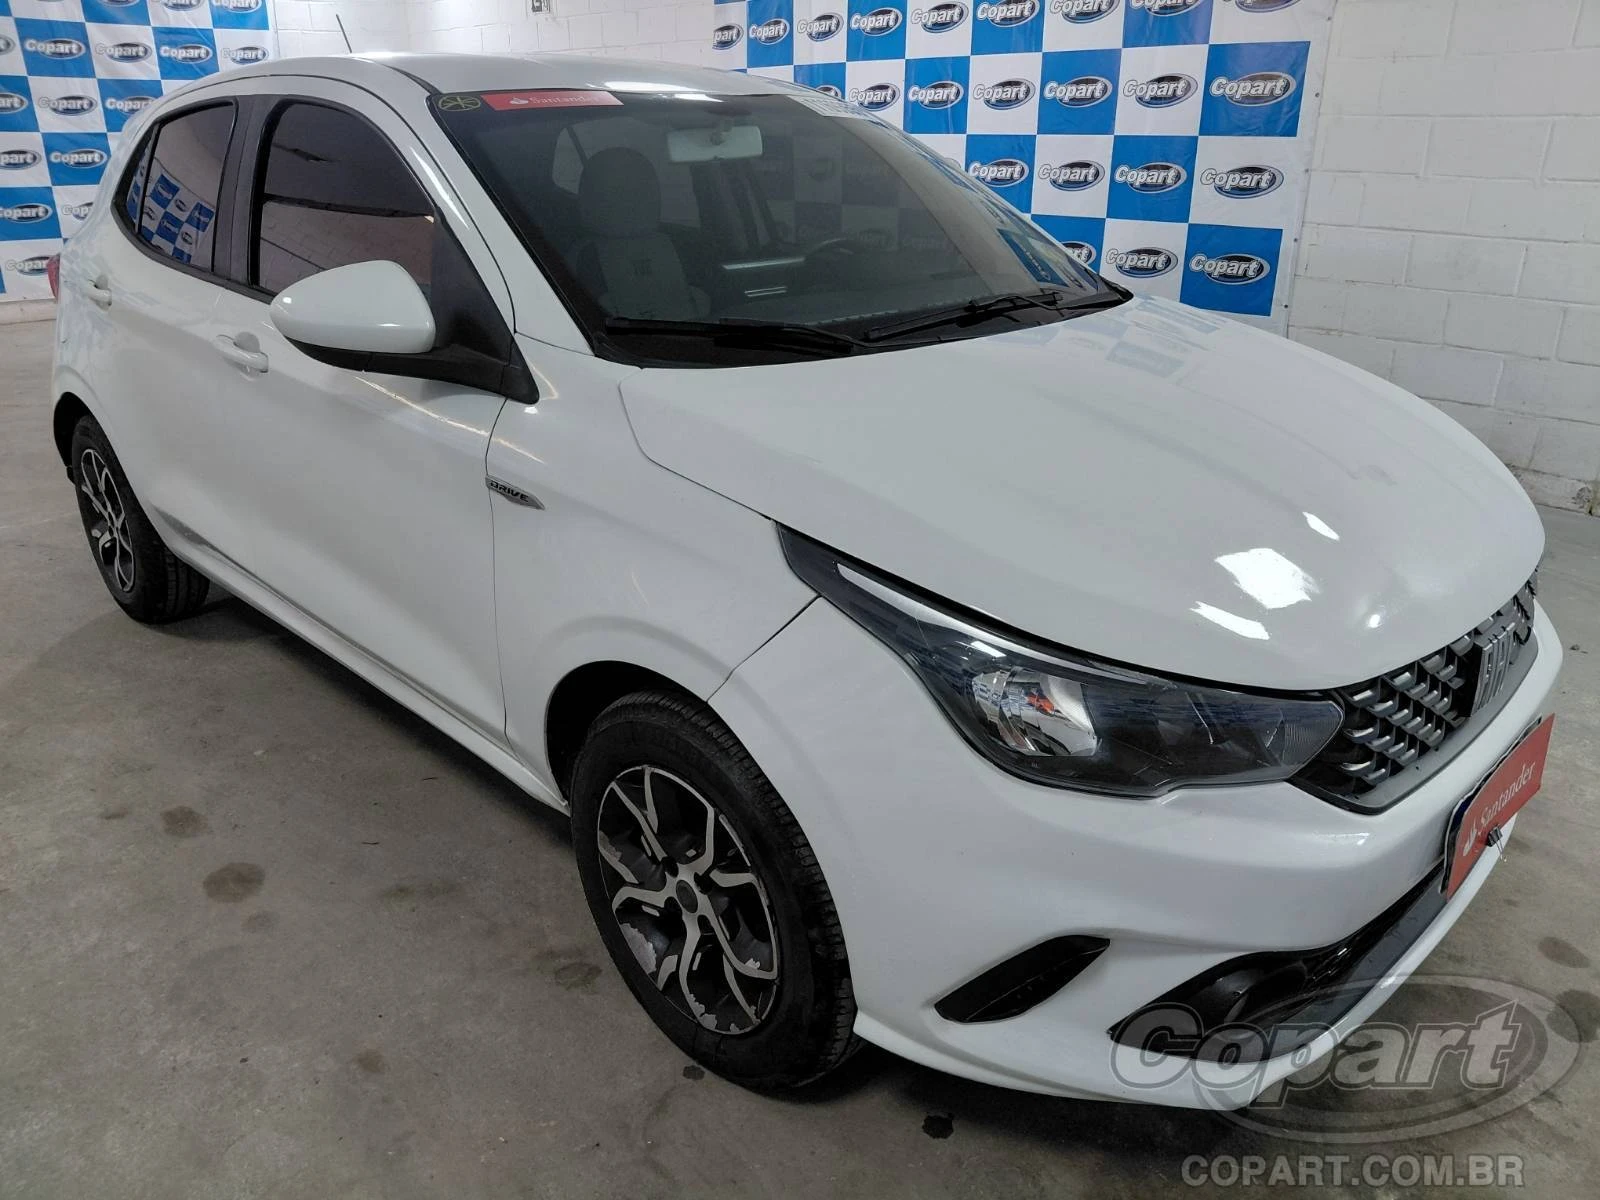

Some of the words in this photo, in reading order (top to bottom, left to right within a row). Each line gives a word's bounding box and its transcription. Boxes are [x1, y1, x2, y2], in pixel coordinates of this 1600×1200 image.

[850, 10, 897, 33] Copart
[911, 4, 961, 27] Copart
[977, 0, 1034, 25] Copart
[712, 27, 737, 46] part
[749, 21, 785, 41] Copart
[797, 17, 837, 36] Copart
[25, 39, 79, 55] Copart
[96, 42, 145, 59] Copart
[160, 46, 207, 60] Copart
[850, 88, 893, 106] Copart
[908, 85, 956, 105] Copart
[973, 80, 1028, 103] Copart
[1043, 77, 1105, 102] Copart
[1122, 76, 1186, 101] Copart
[1209, 76, 1287, 99] Copart
[38, 96, 91, 112] Copart
[105, 97, 151, 112] Copar
[0, 153, 34, 166] part
[51, 152, 101, 167] Copart
[968, 161, 1022, 186] Copart
[1039, 162, 1096, 187] Copart
[1115, 165, 1177, 189] Copart
[1200, 167, 1272, 192] Copart
[63, 204, 93, 218] Cop
[6, 258, 50, 272] Copar
[1105, 247, 1168, 275] Copart
[1190, 254, 1259, 280] Copart
[490, 480, 529, 502] DRIVE
[1480, 761, 1536, 828] Santander
